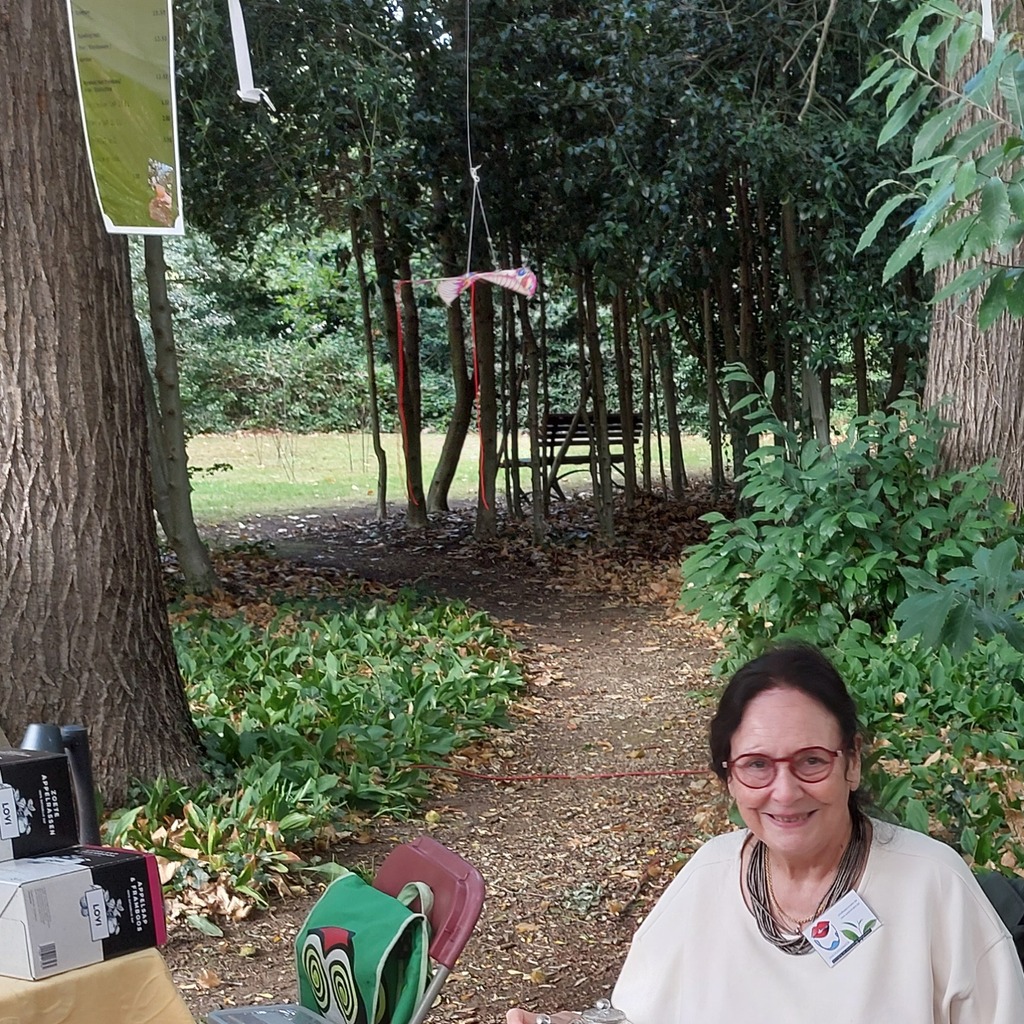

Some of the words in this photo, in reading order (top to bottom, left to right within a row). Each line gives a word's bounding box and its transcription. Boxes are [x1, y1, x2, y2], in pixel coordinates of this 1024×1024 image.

[1, 802, 12, 826] LOVI
[41, 774, 56, 836] APPELRASSEN
[50, 789, 61, 818] ZOETE
[92, 903, 102, 927] LOVI
[131, 885, 143, 933] FRAMBOOS
[137, 881, 149, 925] APPELSAP
